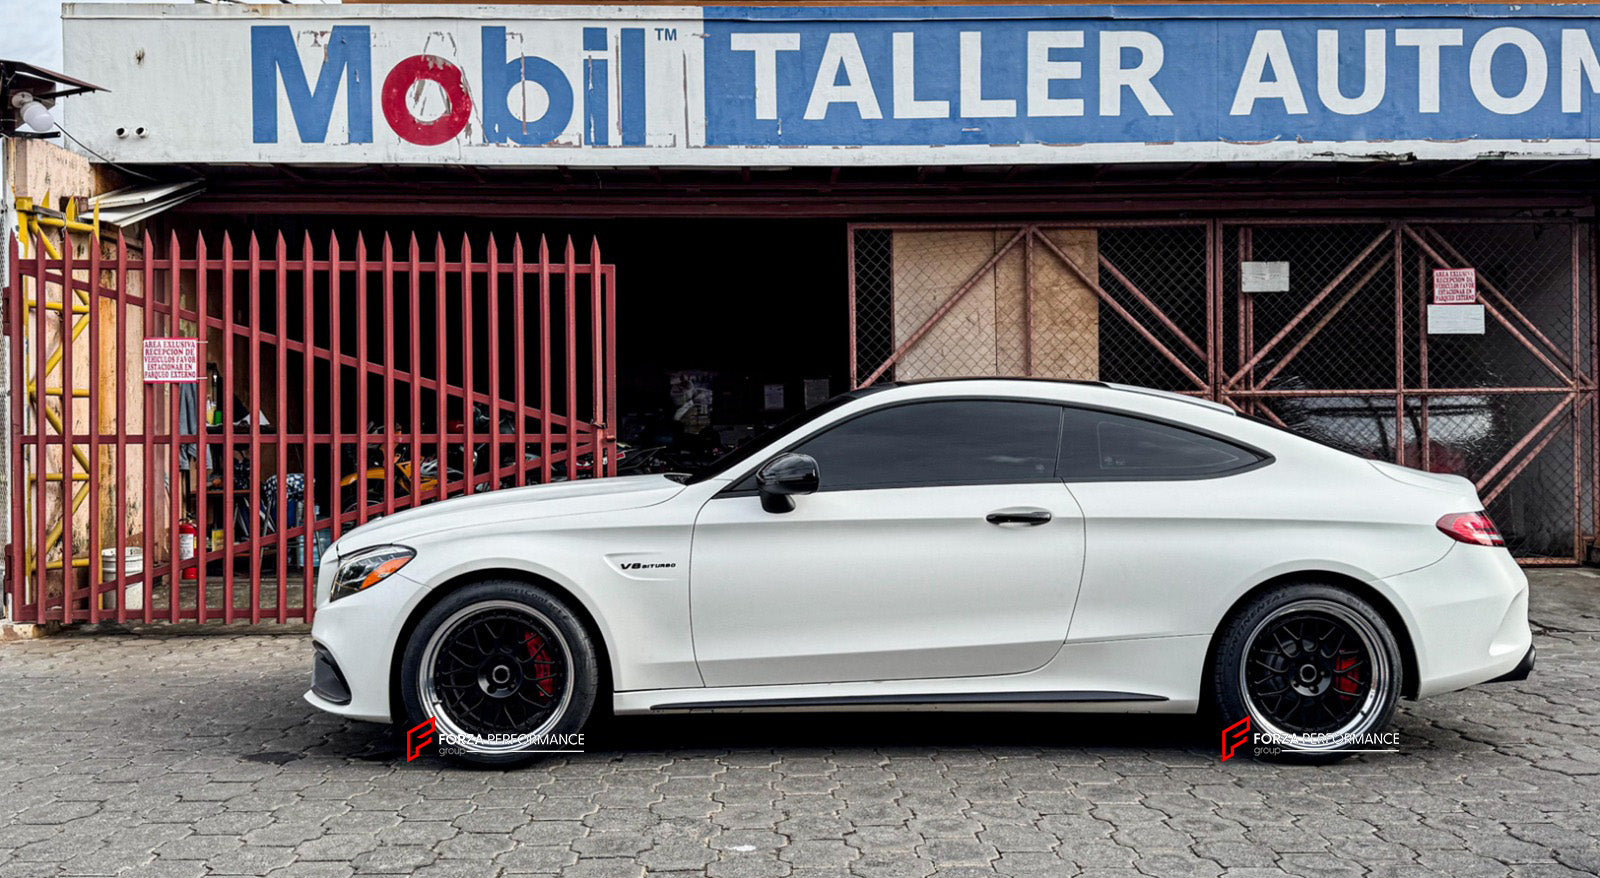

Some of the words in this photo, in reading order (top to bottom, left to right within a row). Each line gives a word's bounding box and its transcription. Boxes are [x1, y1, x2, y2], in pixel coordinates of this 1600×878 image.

[251, 25, 646, 146] Mobil
[730, 30, 1174, 120] TALLER
[144, 371, 169, 379] PARQUEO
[170, 371, 196, 379] EXTERNO
[145, 348, 183, 356] RECEPCION
